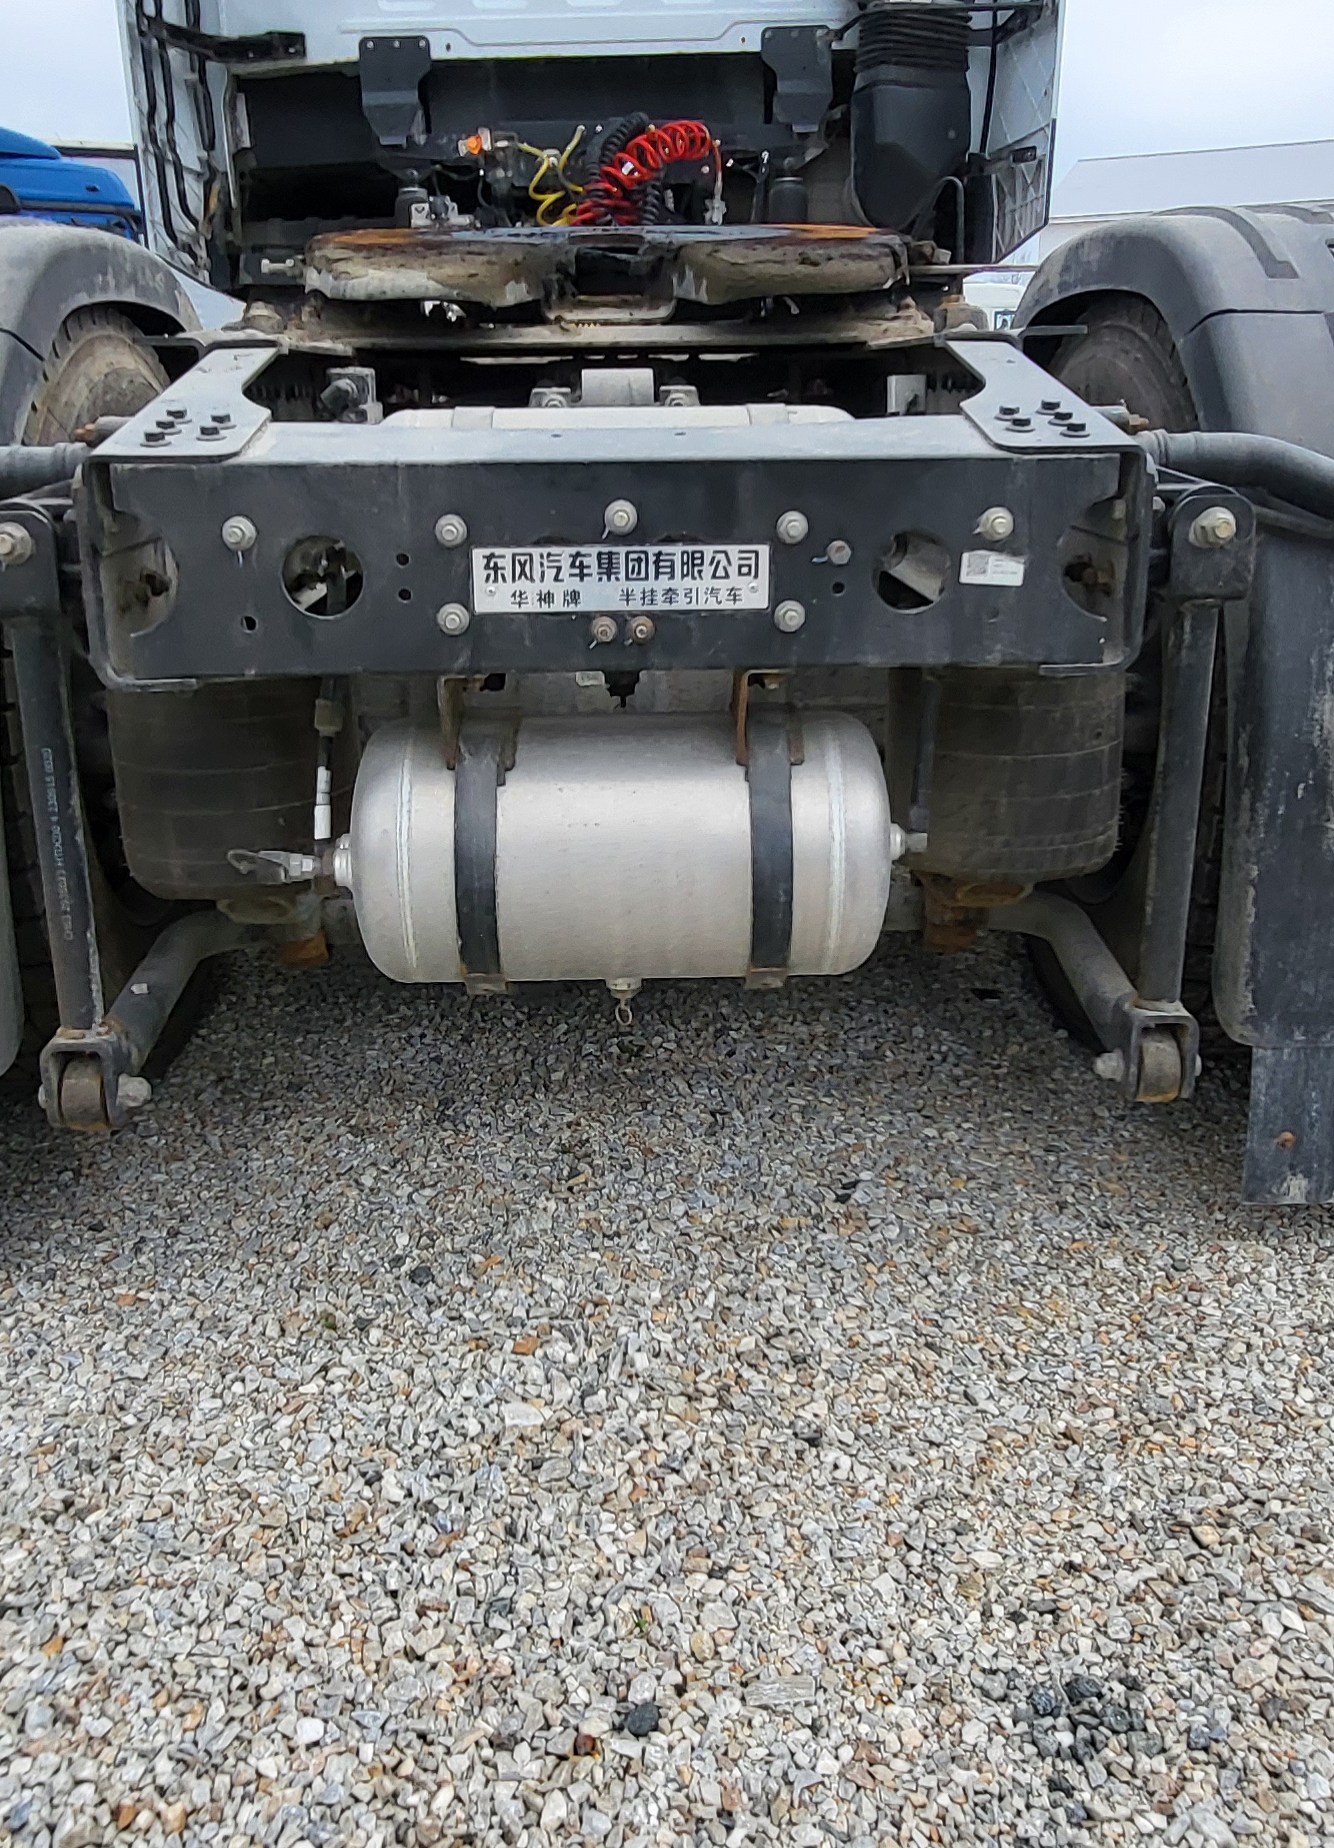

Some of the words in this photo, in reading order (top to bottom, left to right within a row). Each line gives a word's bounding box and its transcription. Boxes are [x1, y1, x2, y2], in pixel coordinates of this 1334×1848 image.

[482, 550, 760, 583] 东风汽车集团有限公司
[510, 588, 581, 609] 华神牌
[619, 587, 743, 606] 半挂牵引汽车
